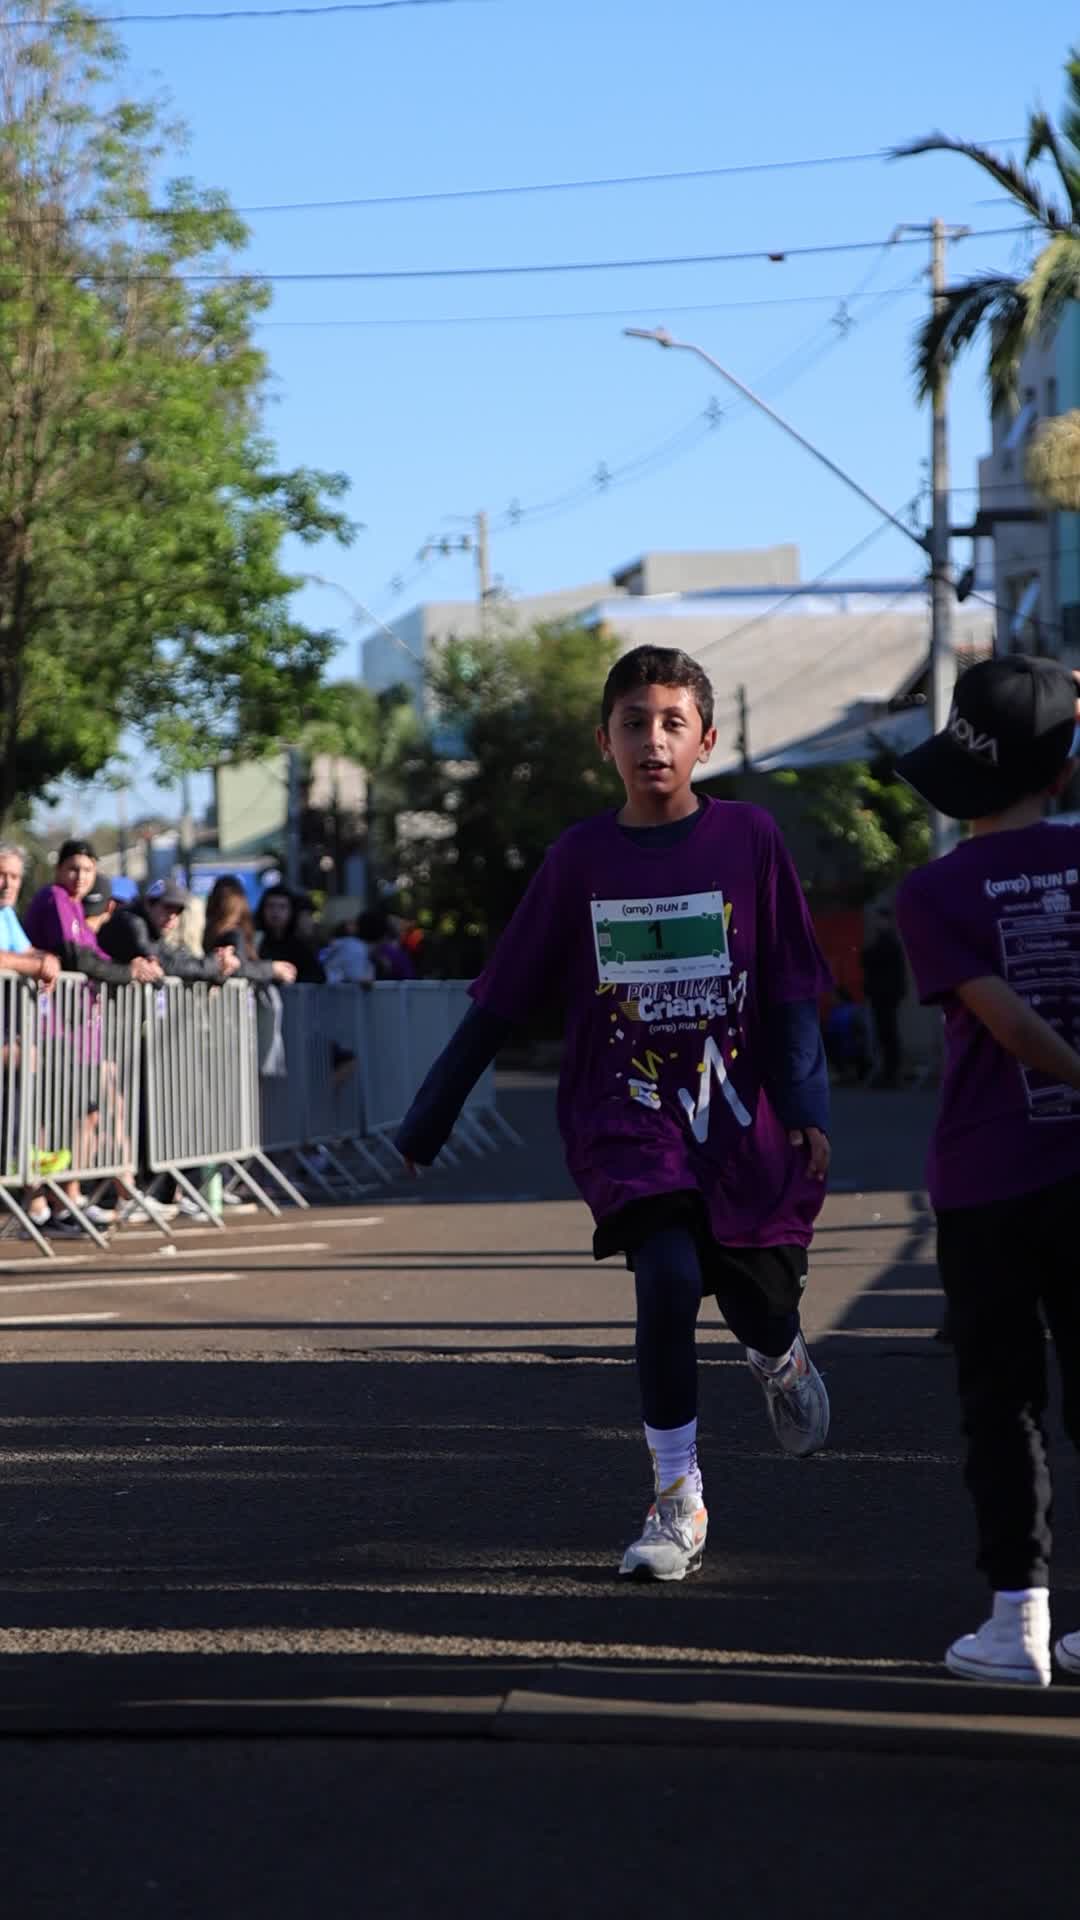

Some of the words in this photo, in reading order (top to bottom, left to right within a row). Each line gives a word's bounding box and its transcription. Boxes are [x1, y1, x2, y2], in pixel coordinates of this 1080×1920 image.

[986, 873, 1031, 898] (amp)
[1032, 873, 1063, 888] RUN
[622, 903, 653, 916] (amp)
[656, 904, 678, 913] RUN
[648, 921, 663, 950] 1
[627, 983, 669, 1003] POR
[674, 976, 722, 999] UMA
[678, 1022, 697, 1030] RUN
